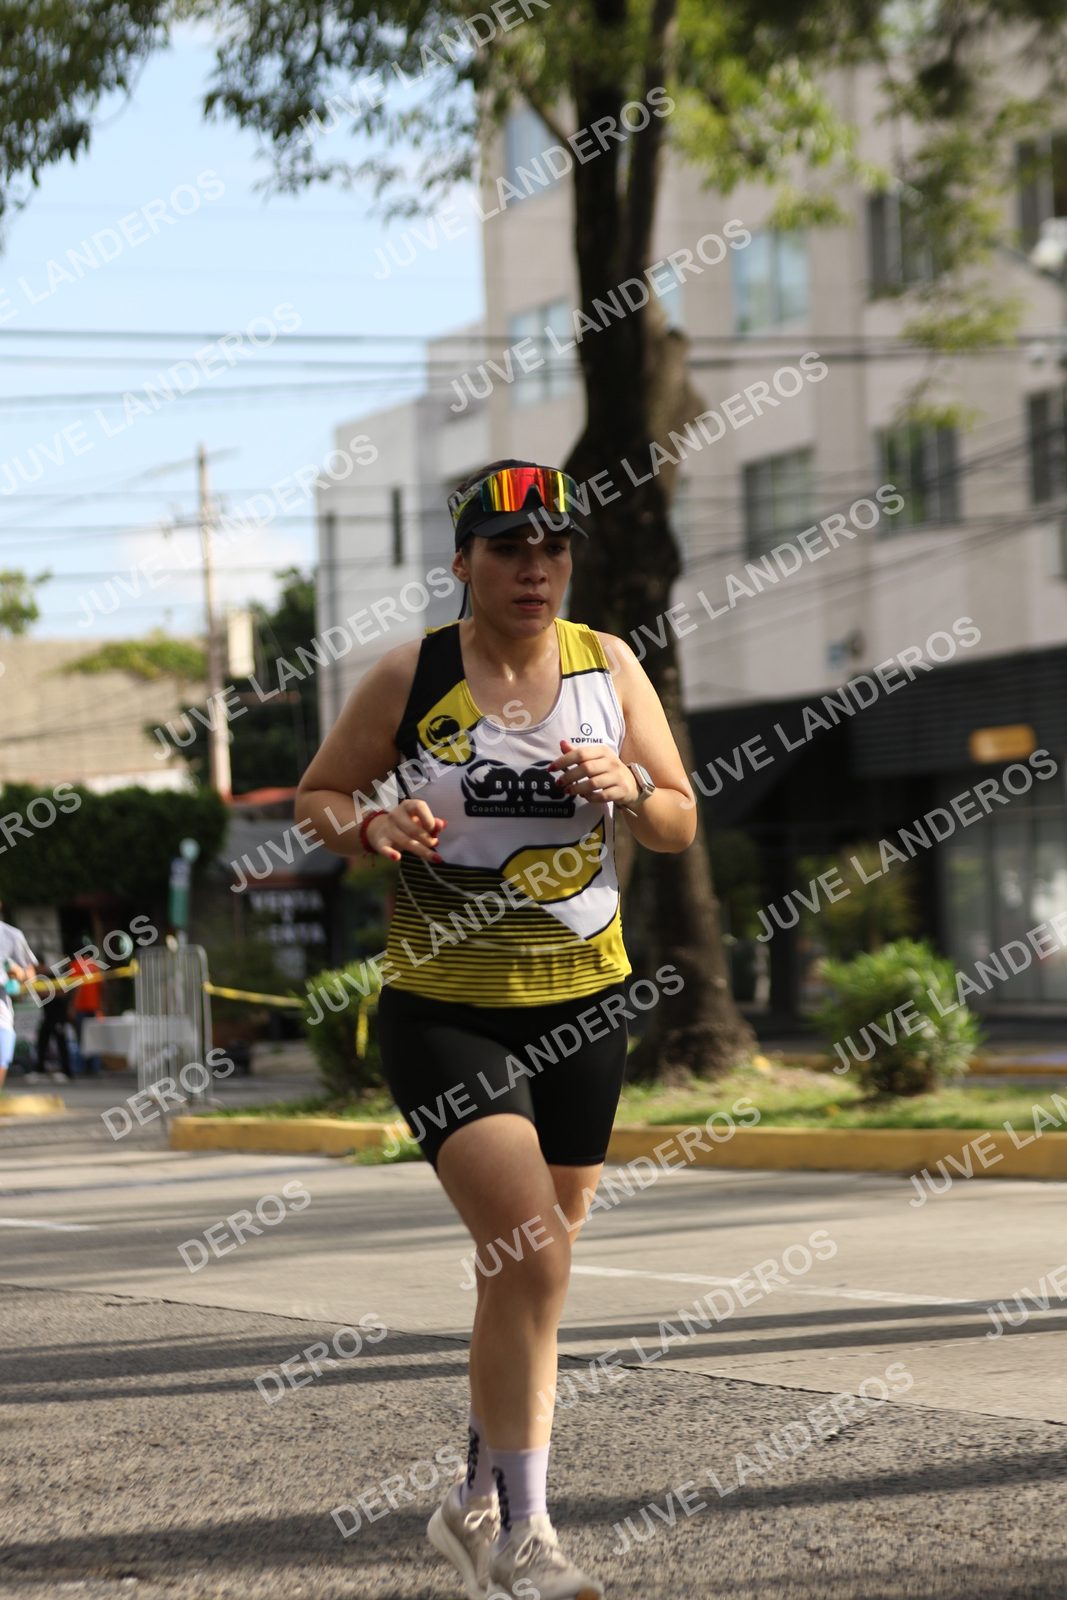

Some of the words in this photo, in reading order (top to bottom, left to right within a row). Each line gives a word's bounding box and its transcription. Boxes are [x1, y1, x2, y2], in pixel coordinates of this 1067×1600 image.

[495, 780, 551, 790] RINOS
[471, 804, 516, 814] Coaching
[519, 805, 526, 813] &
[530, 805, 569, 815] Training
